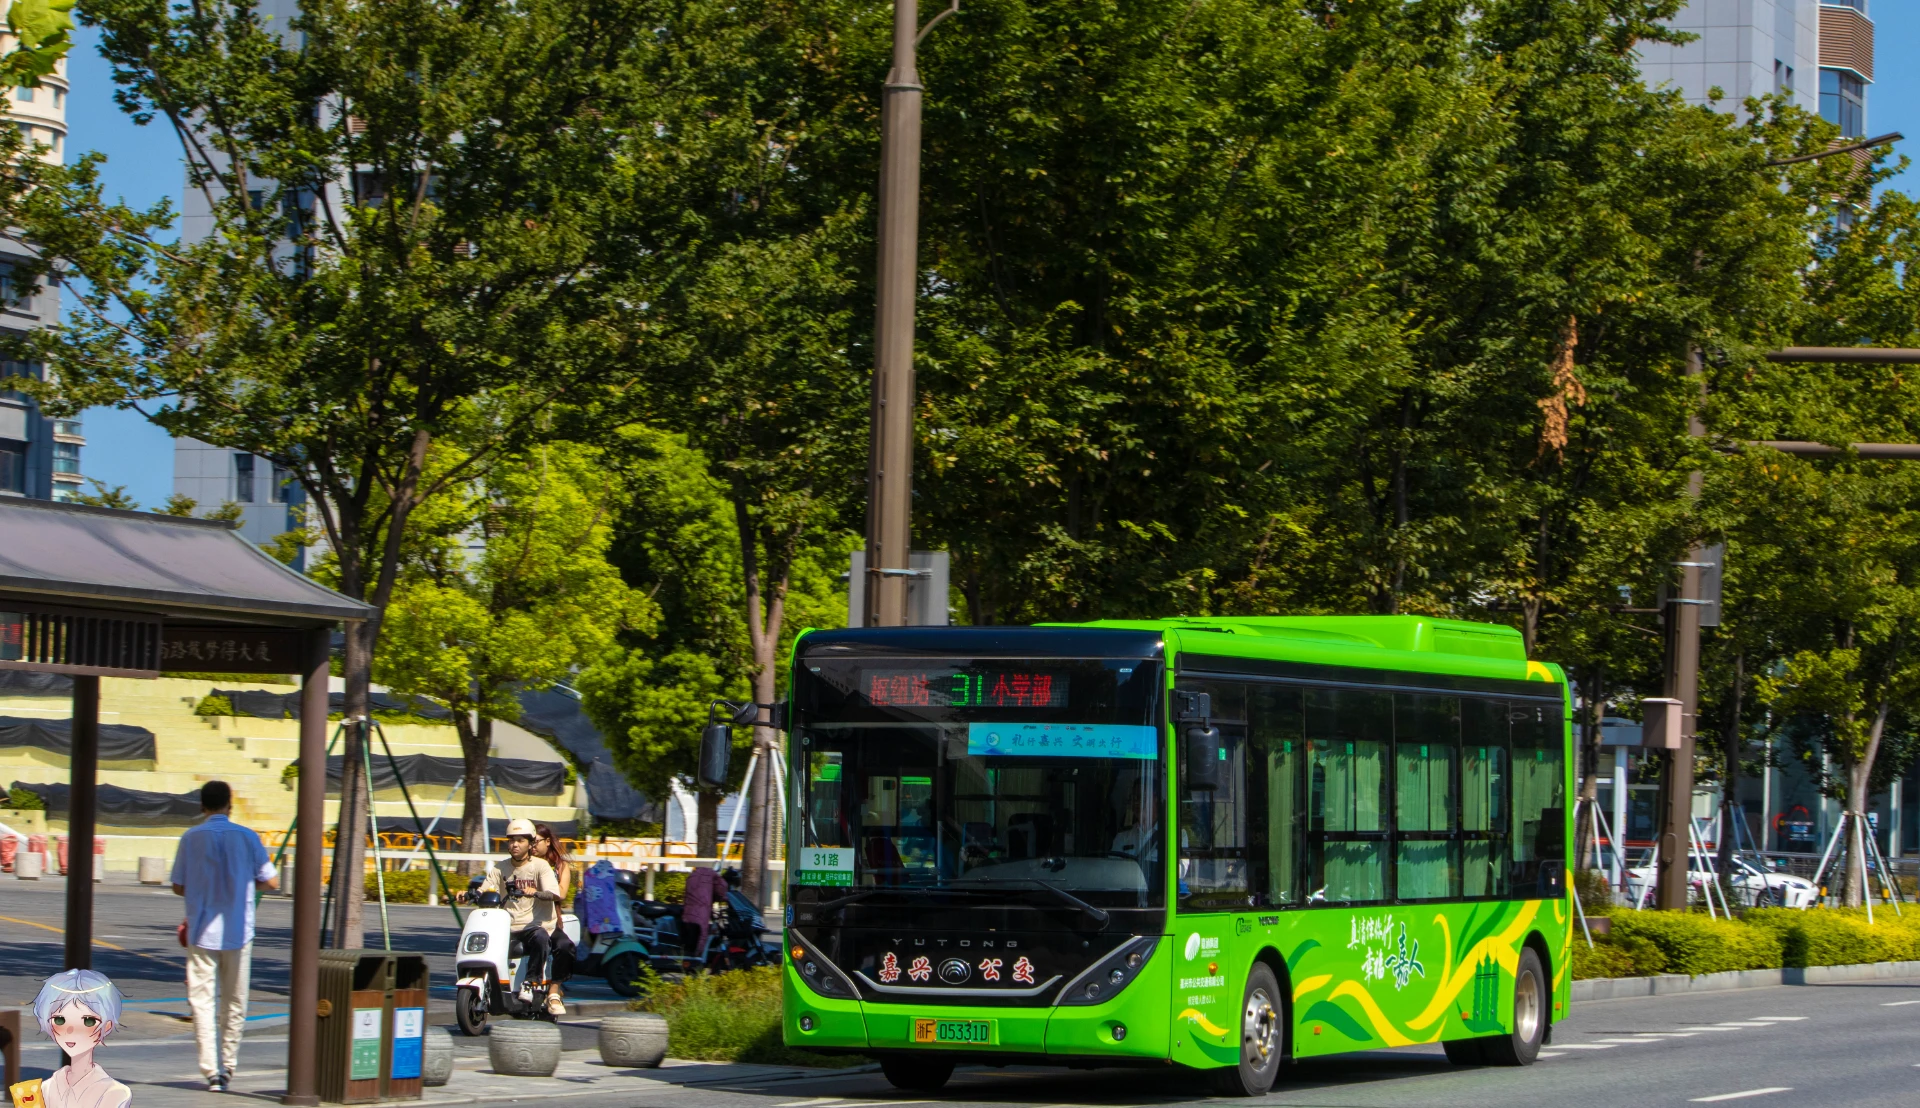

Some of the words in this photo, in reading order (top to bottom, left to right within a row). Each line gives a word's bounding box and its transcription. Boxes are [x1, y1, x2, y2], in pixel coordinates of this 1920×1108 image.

[869, 674, 929, 706] 枢纽站
[951, 674, 983, 706] 31
[992, 674, 1052, 706] 小学部
[1011, 733, 1064, 747] 礼行嘉兴
[1072, 734, 1123, 749] 文明出行
[813, 853, 839, 867] 31路
[892, 938, 1018, 948] YUTONG
[878, 952, 932, 983] 嘉兴
[979, 956, 1035, 984] 公交
[916, 1021, 934, 1039] 浙F
[939, 1023, 989, 1041] 05331D
